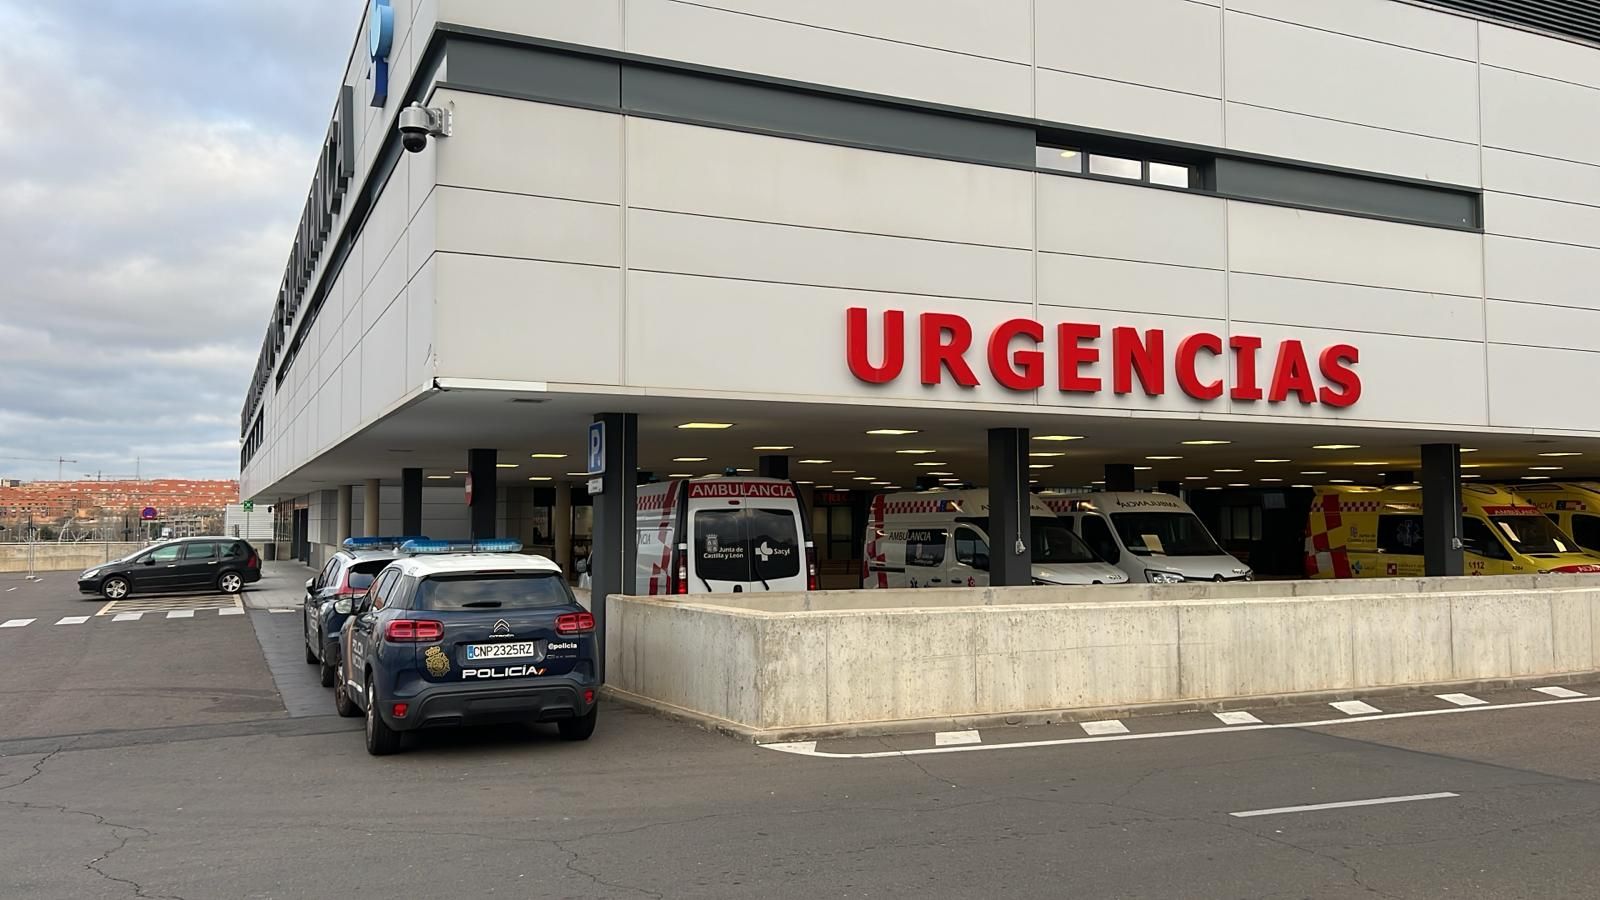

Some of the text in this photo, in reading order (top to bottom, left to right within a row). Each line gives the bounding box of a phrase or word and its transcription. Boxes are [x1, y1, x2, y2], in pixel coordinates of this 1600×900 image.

[846, 307, 1362, 408] URGENCIAS
[591, 429, 600, 468] P
[691, 483, 795, 497] AMBULANCIA
[889, 531, 931, 542] AMBULANCIA
[1472, 561, 1485, 570] 112
[474, 643, 532, 657] CNP2325RZ
[462, 664, 538, 679] POLICÍA
